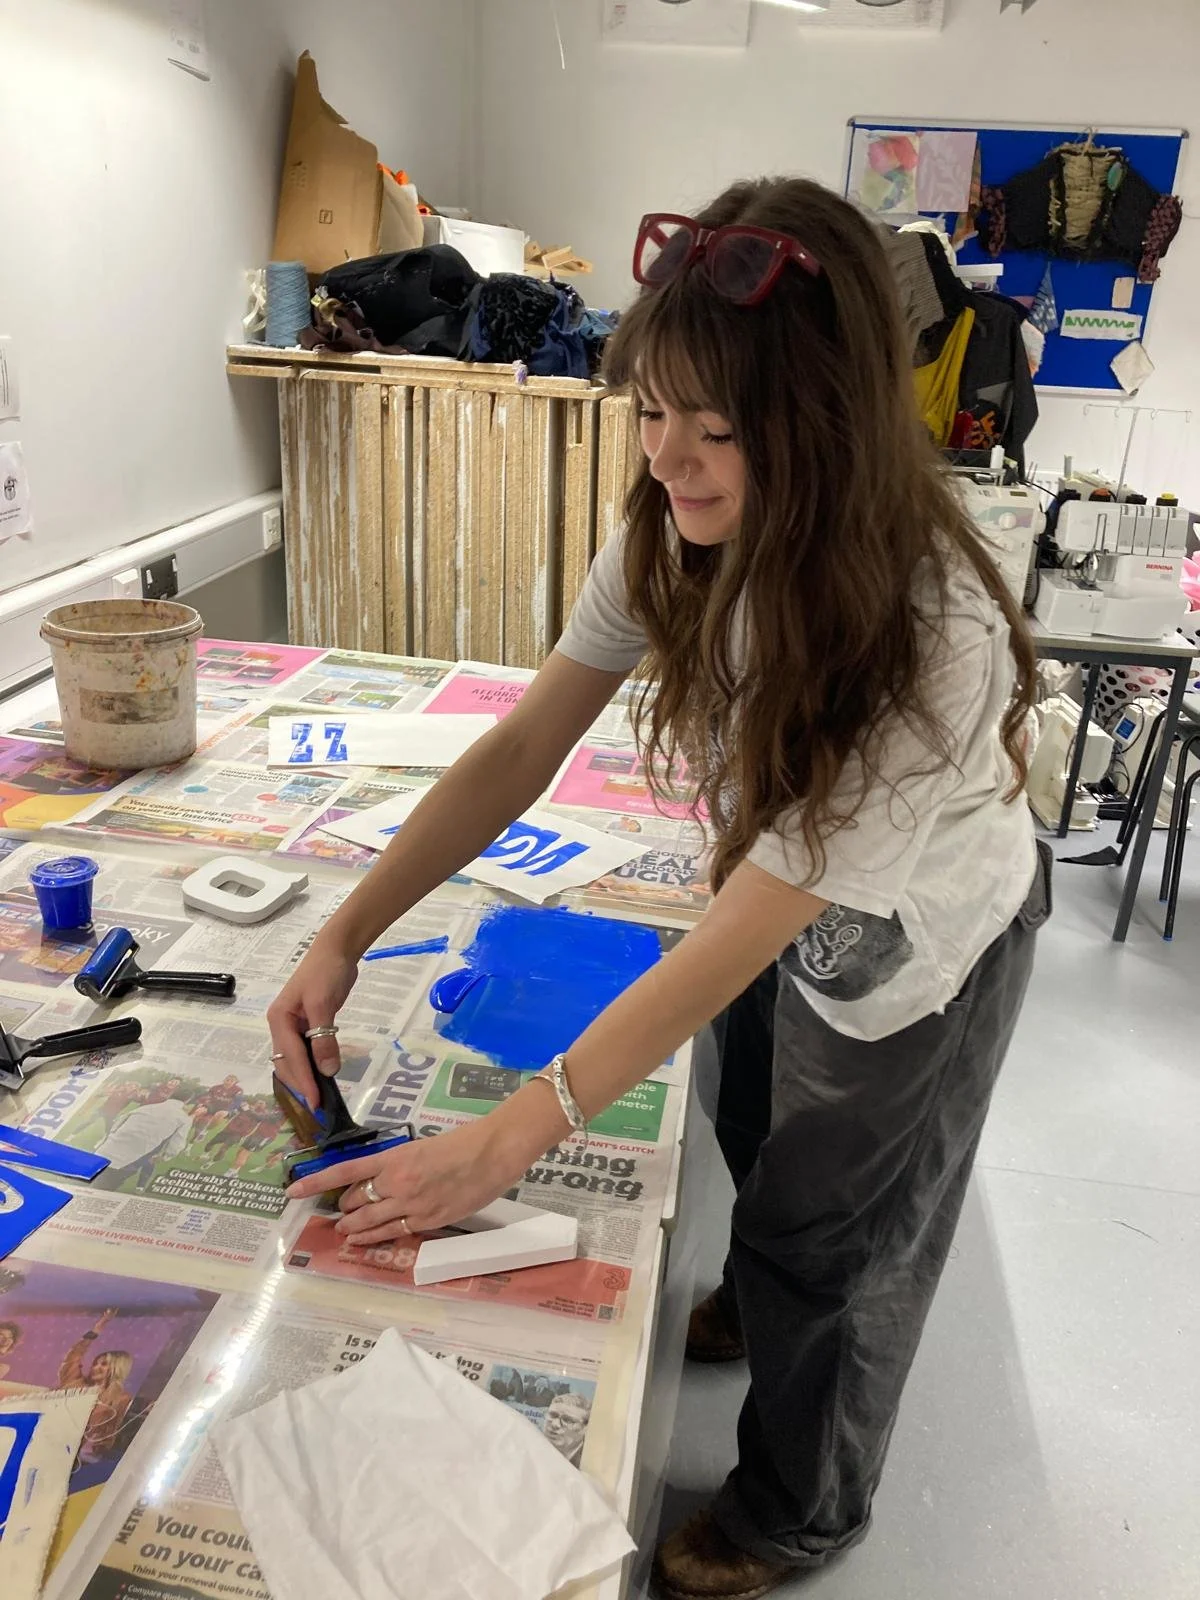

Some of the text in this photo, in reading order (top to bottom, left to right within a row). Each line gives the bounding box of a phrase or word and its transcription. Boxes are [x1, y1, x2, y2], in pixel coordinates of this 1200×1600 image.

[1145, 563, 1174, 571] BERNINA
[472, 688, 518, 698] AFFORD
[129, 799, 147, 807] You
[149, 801, 180, 811] could
[180, 806, 204, 814] save
[205, 810, 219, 818] up
[138, 806, 161, 816] your
[181, 811, 234, 825] insurance
[630, 854, 698, 871] EAL
[615, 868, 696, 886] UGLY
[578, 1137, 618, 1150] GIANT'S
[619, 1144, 655, 1155] GLITCH
[169, 1168, 228, 1186] Goal-shy
[154, 1175, 286, 1204] feeling the love and
[182, 1190, 207, 1200] has
[207, 1194, 243, 1207] right
[105, 1230, 154, 1245] LIVERPOOL
[155, 1239, 175, 1248] CAN
[175, 1242, 195, 1252] END
[196, 1246, 223, 1257] THEIR
[223, 1252, 255, 1263] SLUMP
[345, 1334, 360, 1347] Is
[154, 1514, 253, 1553] You coul
[140, 1542, 266, 1582] on your ca
[132, 1564, 156, 1576] Think
[156, 1571, 179, 1580] your
[180, 1575, 217, 1589] renewal
[217, 1582, 245, 1594] quote
[128, 1584, 162, 1597] Compare
